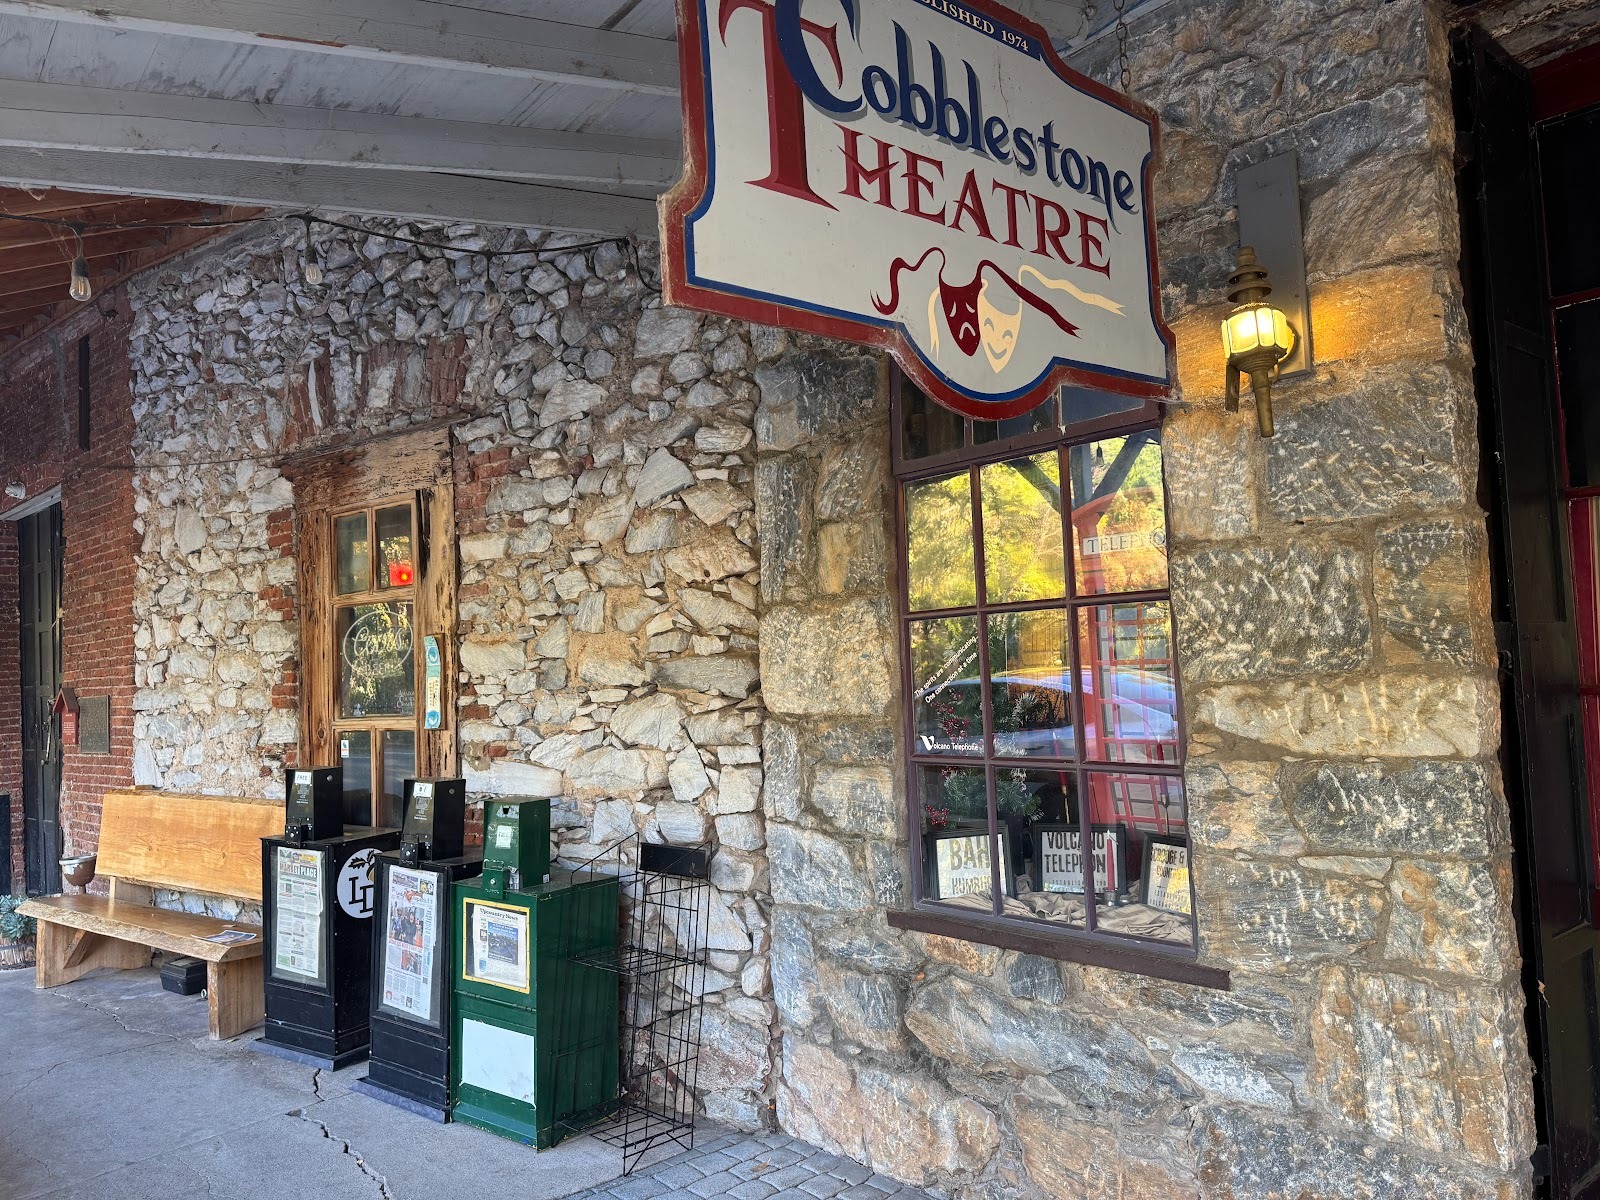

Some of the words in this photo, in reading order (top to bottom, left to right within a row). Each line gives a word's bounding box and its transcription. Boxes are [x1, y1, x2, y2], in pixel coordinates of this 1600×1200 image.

[1001, 30, 1029, 52] 1974
[774, 0, 1139, 232] Cobblestone
[718, 0, 1113, 279] THEATRE
[914, 687, 924, 697] The
[923, 675, 937, 690] spirits
[936, 668, 944, 678] are
[925, 693, 936, 703] One
[934, 670, 959, 695] connection
[957, 665, 964, 673] at
[966, 652, 978, 664] time
[920, 735, 950, 751] Volcano
[951, 742, 979, 751] Telephone
[949, 834, 991, 871] BAH
